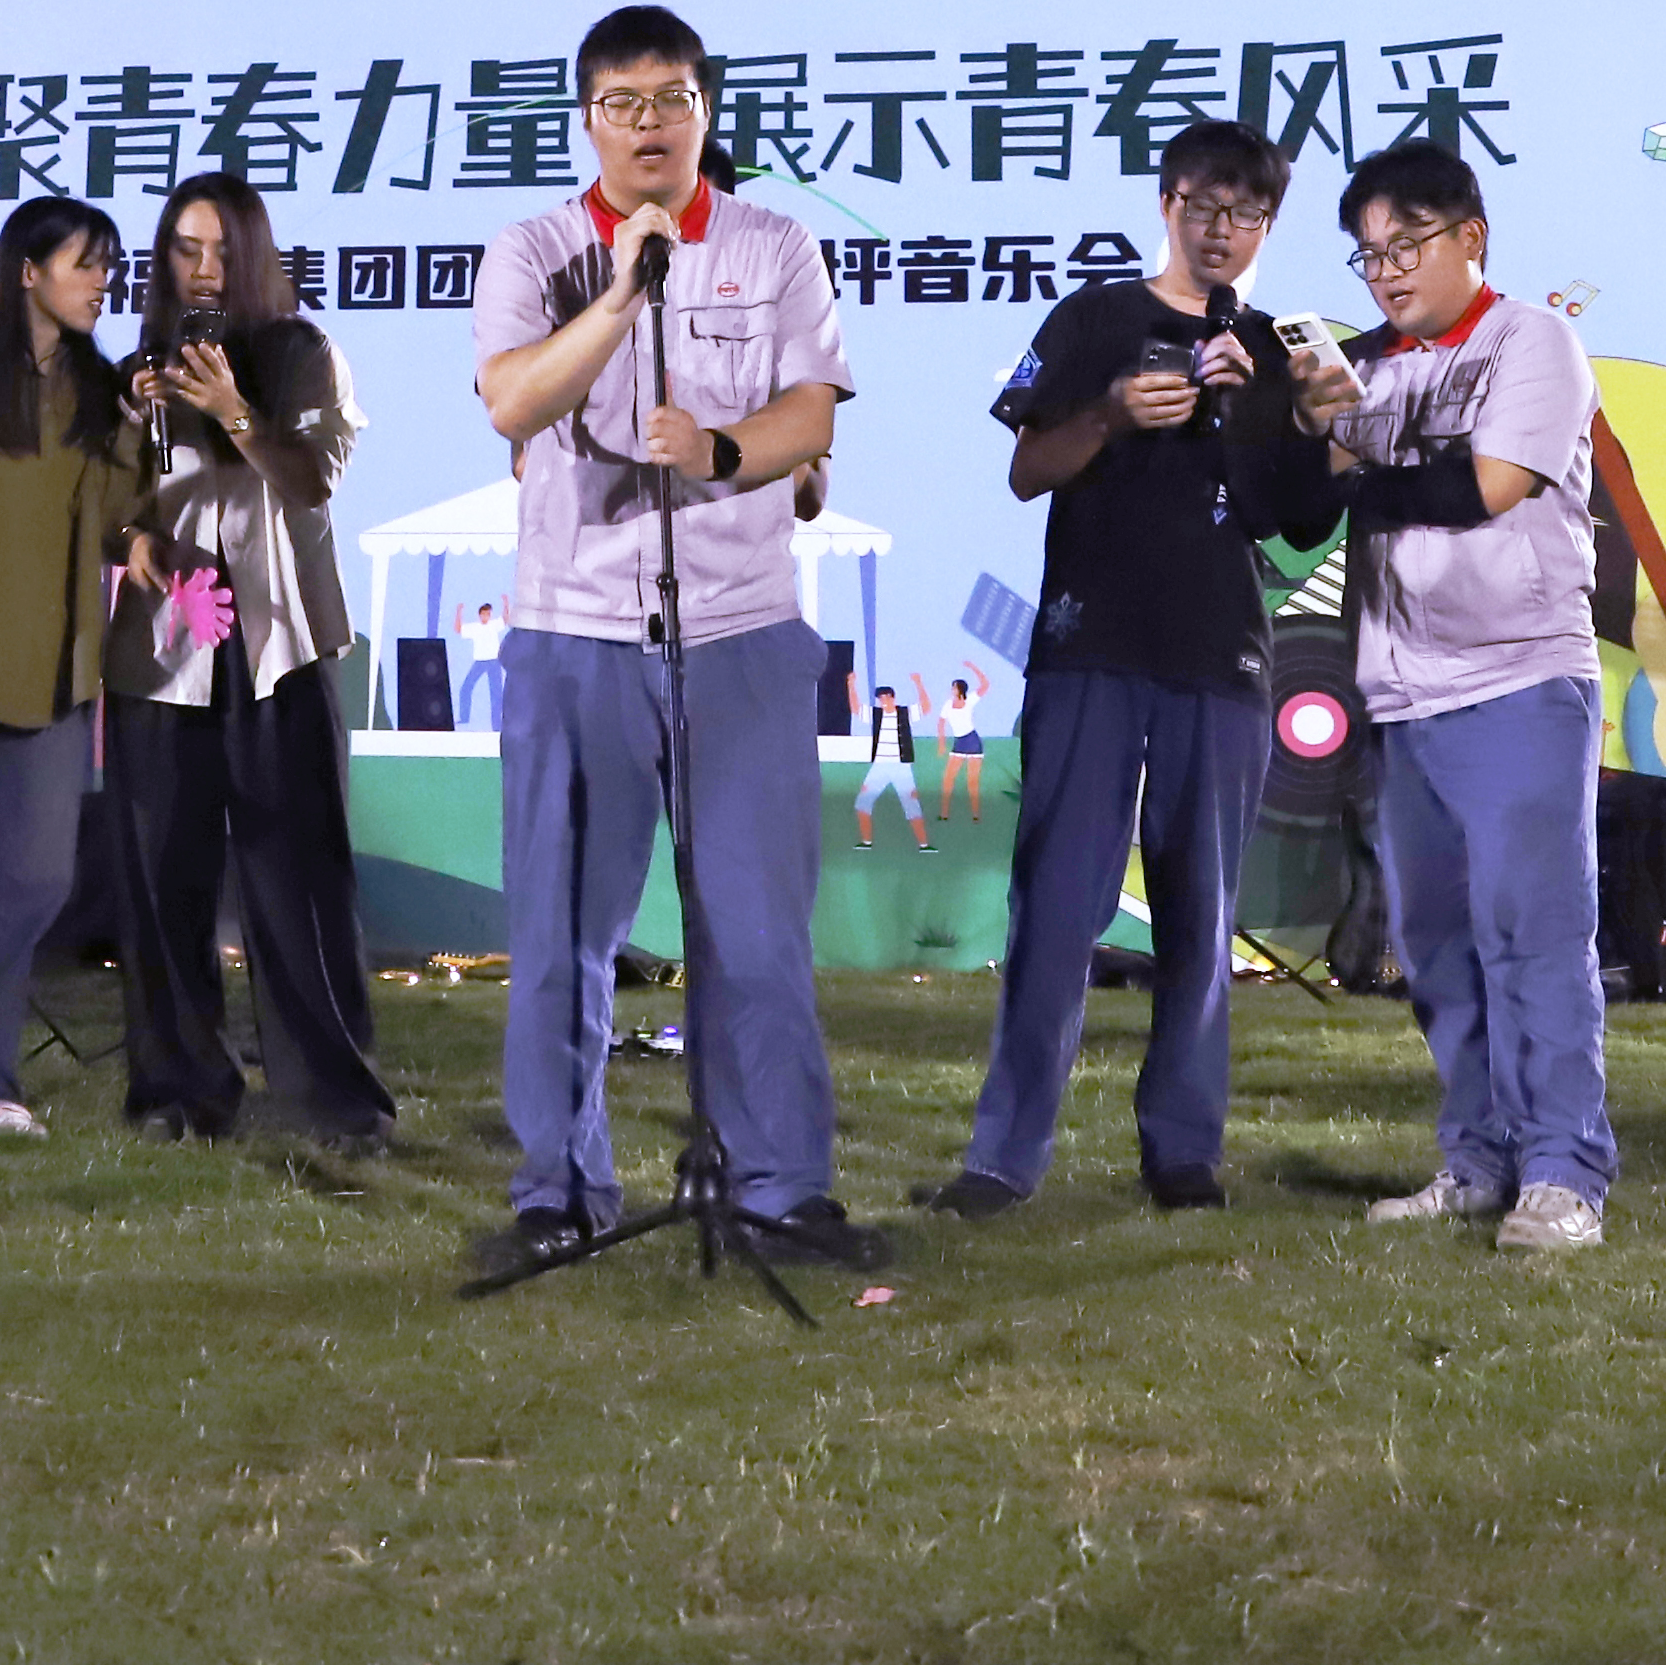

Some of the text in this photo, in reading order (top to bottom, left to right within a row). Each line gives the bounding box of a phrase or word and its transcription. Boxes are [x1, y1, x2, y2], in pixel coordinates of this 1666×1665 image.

[707, 33, 1517, 185] 展示青春风采
